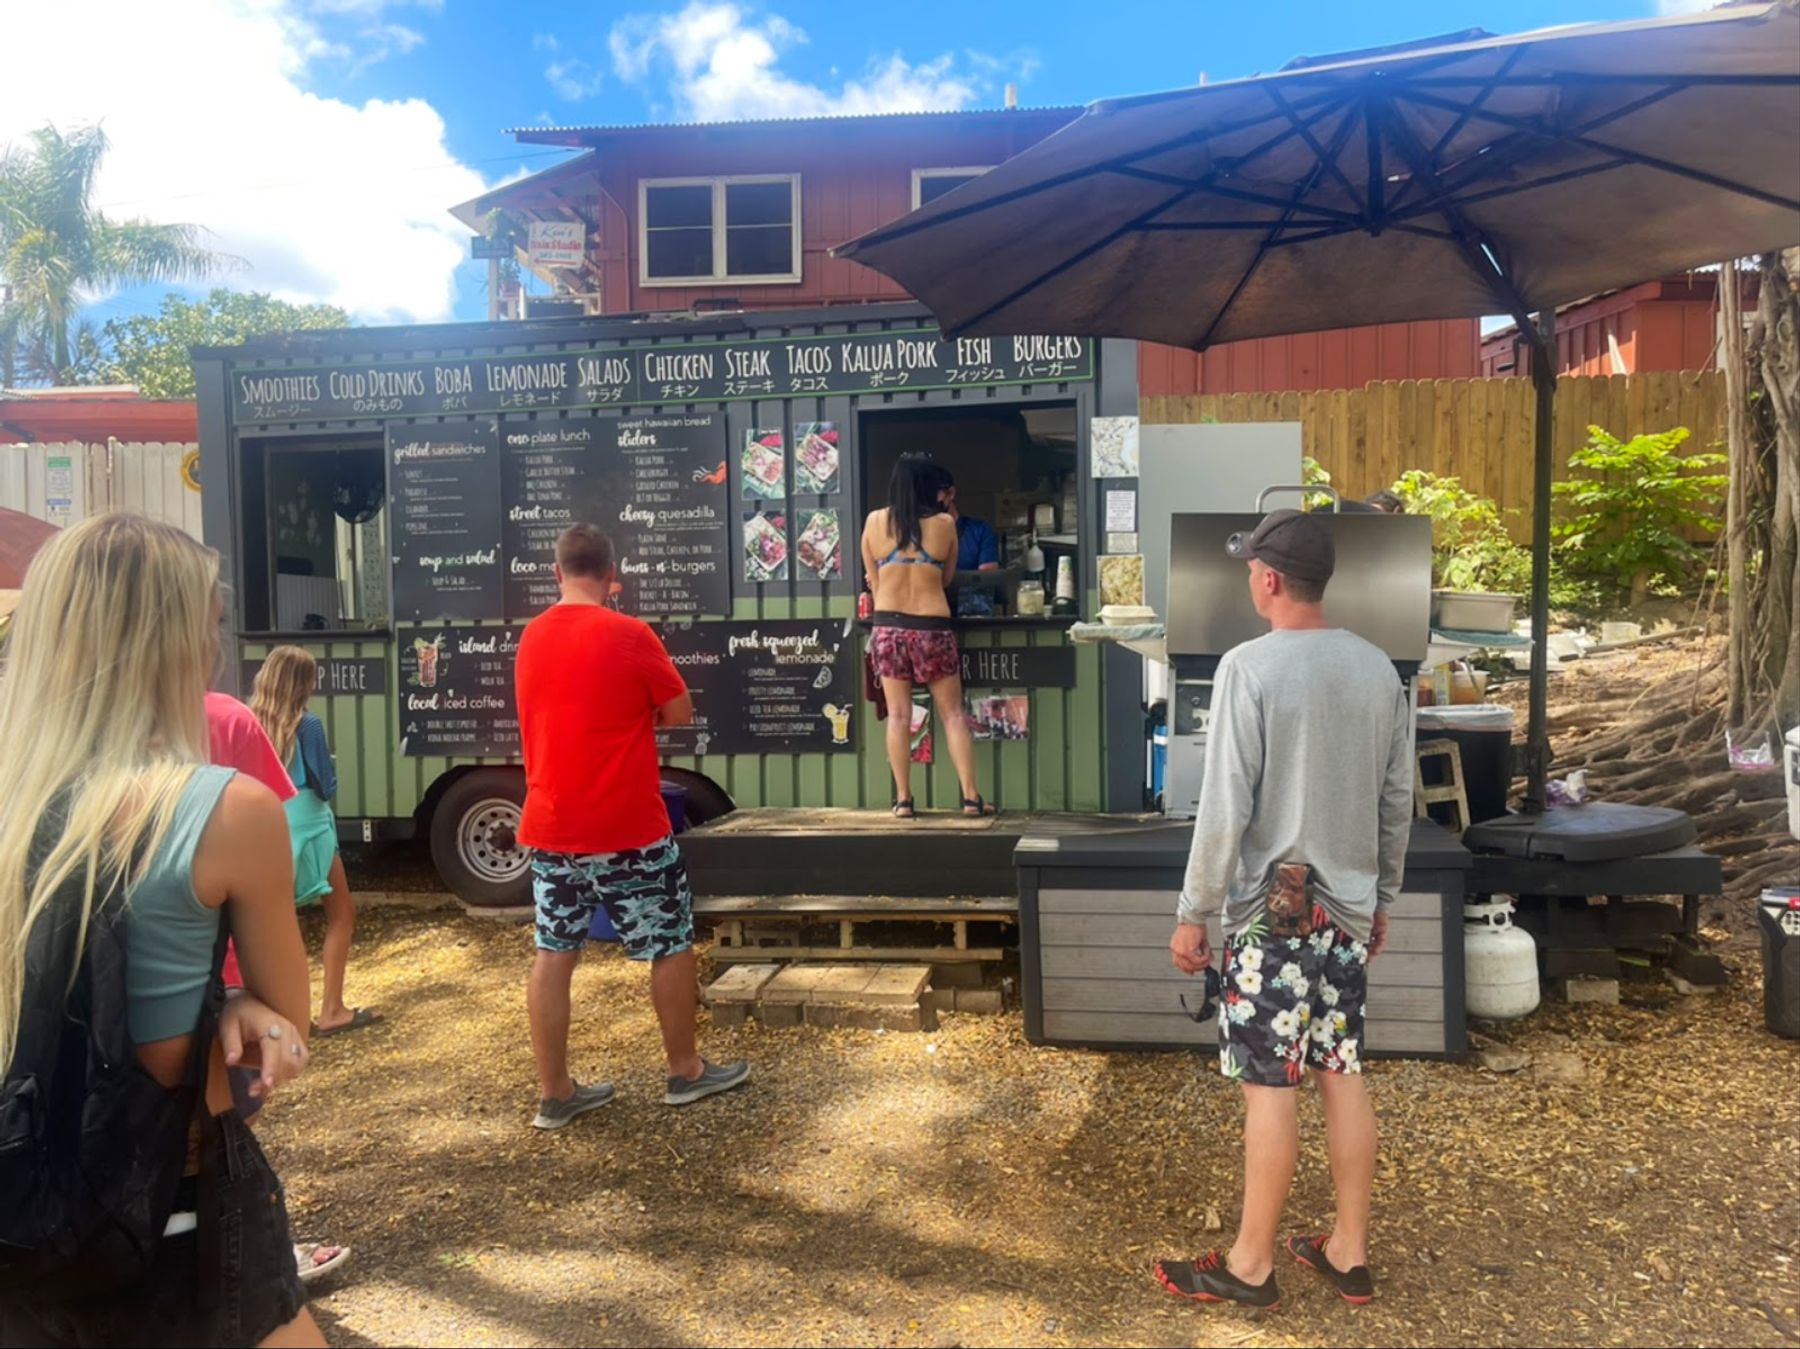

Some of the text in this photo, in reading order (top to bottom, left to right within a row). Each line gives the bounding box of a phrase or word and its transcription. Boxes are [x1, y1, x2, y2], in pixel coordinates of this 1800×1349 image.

[644, 335, 1082, 383] CHICKEN STEAK TACOS KALUA PORK FISH BURGERS
[241, 355, 632, 405] SMOOTHIES COLD DRINKS BOBA LEMONADE SALADS
[660, 361, 1078, 399] チキン ステーキ タコス ポーク フィッシュ バーガー
[252, 404, 311, 421] スムージー
[352, 397, 404, 413] のみもの
[499, 389, 562, 408] レモネード
[586, 386, 624, 403] サラダ
[617, 416, 712, 430] sweet hawaiian bread
[531, 430, 558, 447] plate
[560, 428, 591, 442] lunch
[394, 441, 486, 465] grilled sandwiches
[509, 504, 571, 521] street tacos
[619, 504, 656, 529] cheesy
[657, 505, 715, 522] quesadilla
[444, 553, 464, 566] and
[466, 549, 495, 565] salad
[510, 556, 557, 574] loco mo
[671, 558, 716, 575] burgers
[458, 636, 497, 654] island
[728, 628, 819, 657] fresh squeezed
[671, 651, 720, 665] moothies
[775, 650, 834, 664] lemonade
[979, 651, 1020, 681] HERE
[331, 663, 367, 690] HERE
[407, 693, 505, 710] local iced coffee
